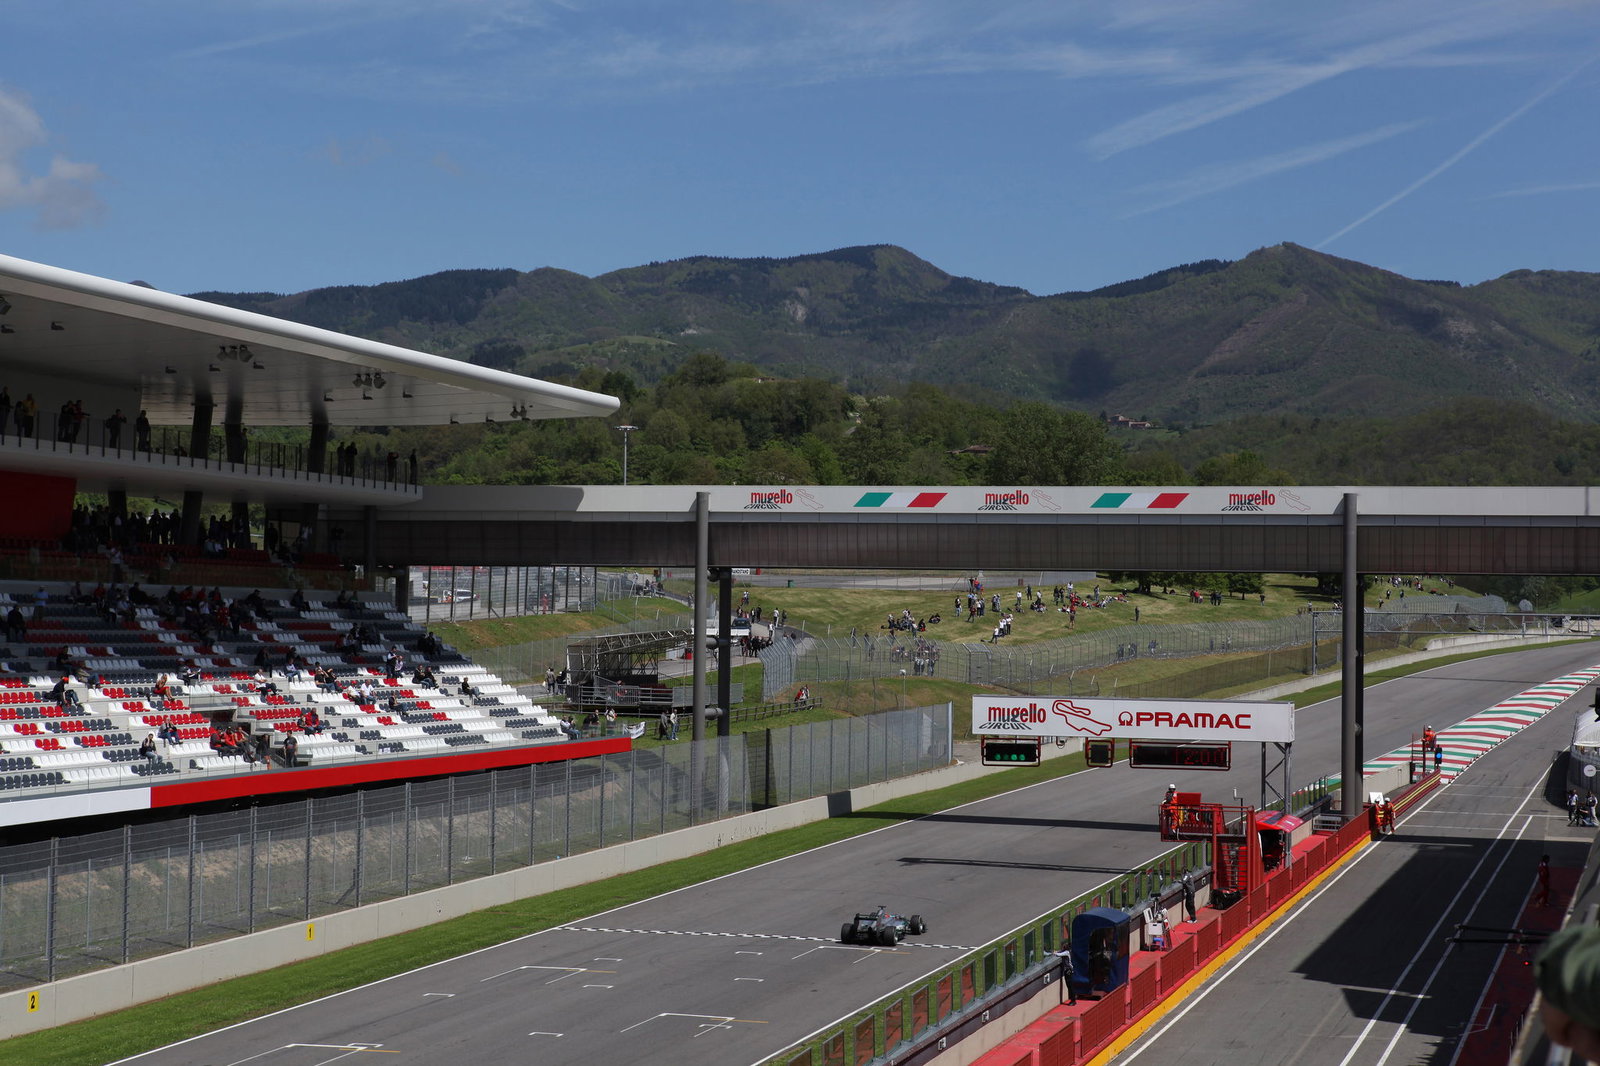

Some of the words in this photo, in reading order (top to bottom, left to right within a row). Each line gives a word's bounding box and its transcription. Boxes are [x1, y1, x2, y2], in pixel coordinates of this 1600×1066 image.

[750, 489, 793, 504] mugello
[985, 490, 1030, 505] mugello
[1229, 490, 1276, 505] mugello
[988, 703, 1046, 723] mugello
[1136, 712, 1251, 729] PRAMAC
[979, 722, 1032, 730] CIRCUIT
[30, 994, 36, 1009] 2
